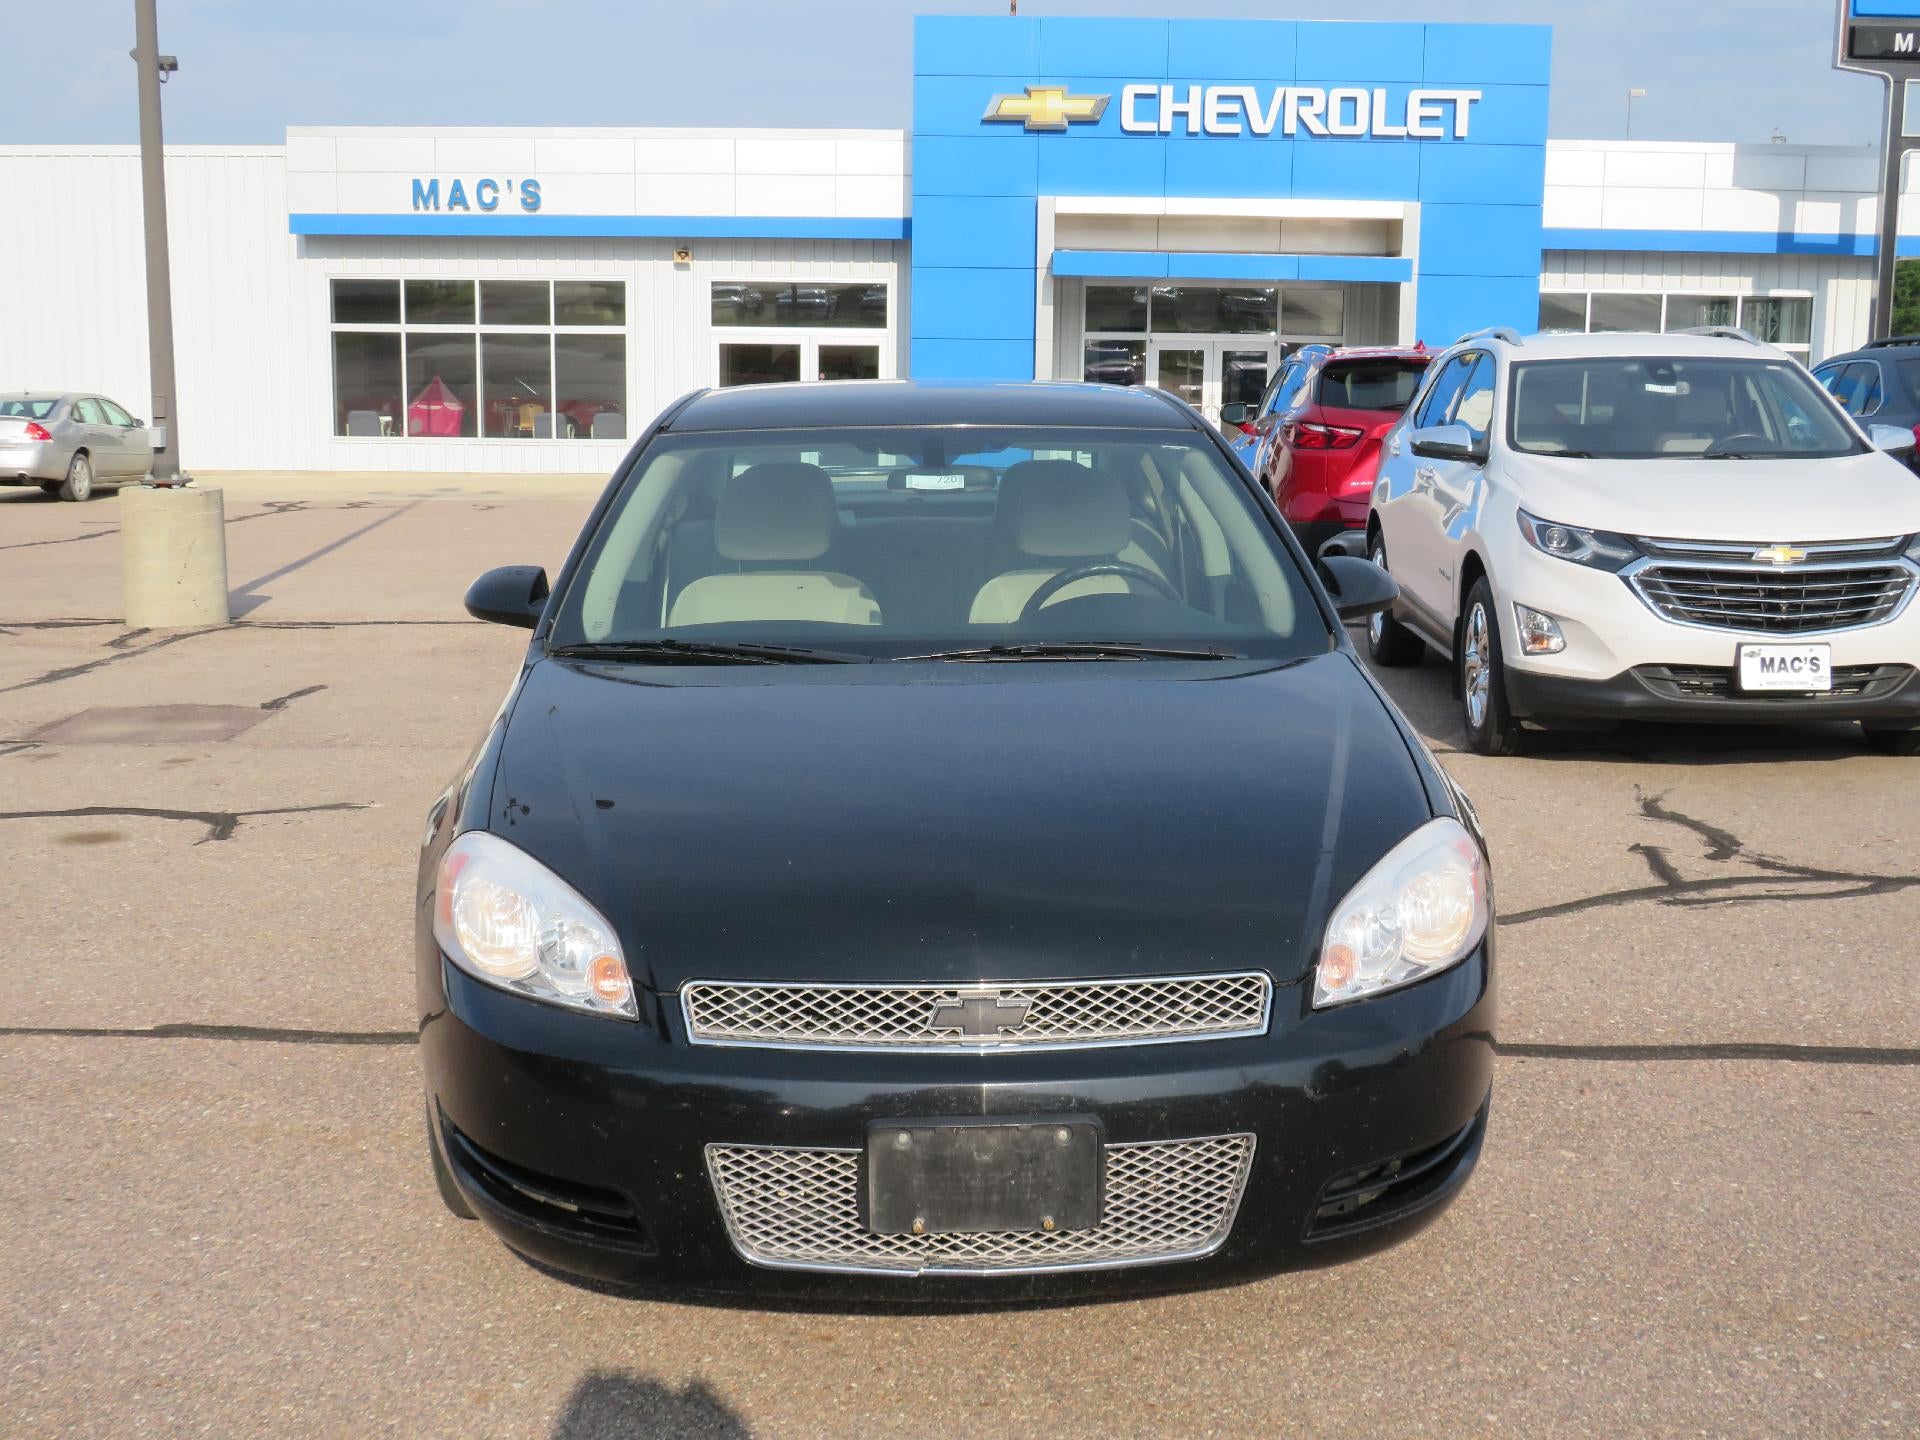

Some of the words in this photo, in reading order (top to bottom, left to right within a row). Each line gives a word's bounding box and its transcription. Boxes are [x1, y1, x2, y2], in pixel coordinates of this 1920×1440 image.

[1893, 32, 1920, 53] M
[1120, 84, 1482, 137] CHEVROLET
[412, 178, 542, 213] MAC'S
[1760, 656, 1820, 673] MAC'S
